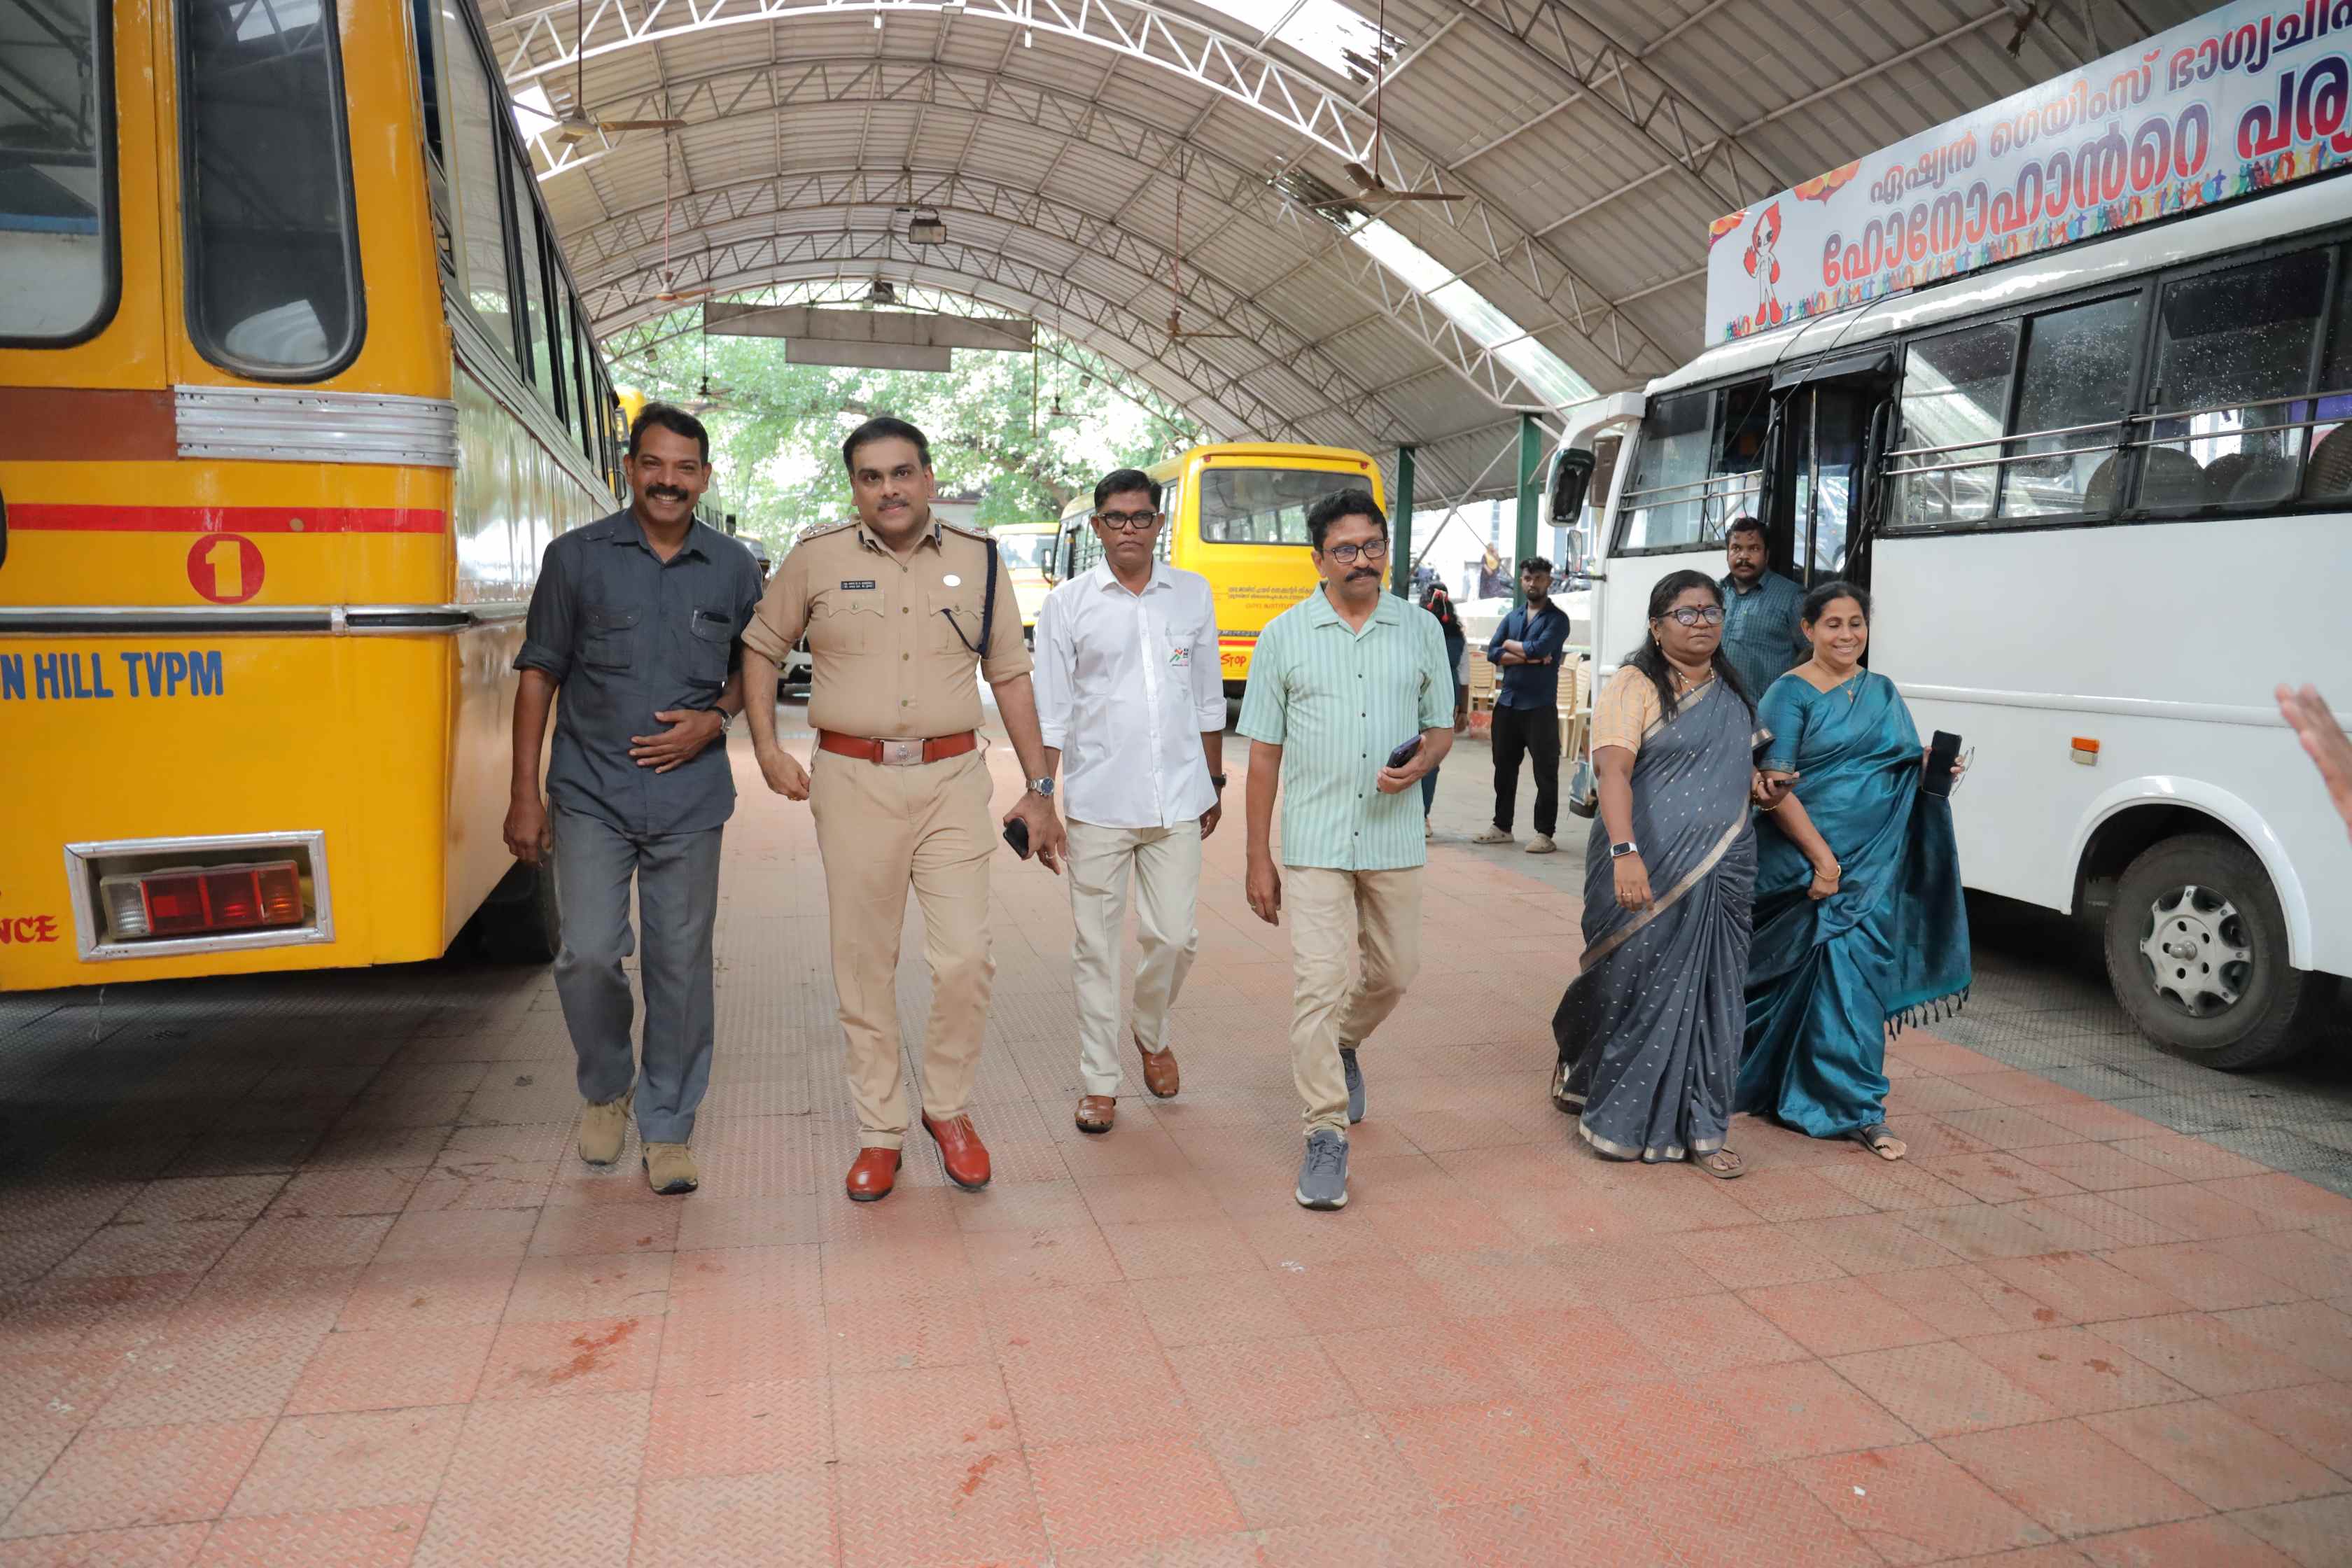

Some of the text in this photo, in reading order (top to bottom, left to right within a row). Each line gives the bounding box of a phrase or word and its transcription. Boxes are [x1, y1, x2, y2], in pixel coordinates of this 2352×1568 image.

[205, 540, 242, 596] 1
[34, 652, 114, 699] HILL
[120, 650, 224, 697] TVPM
